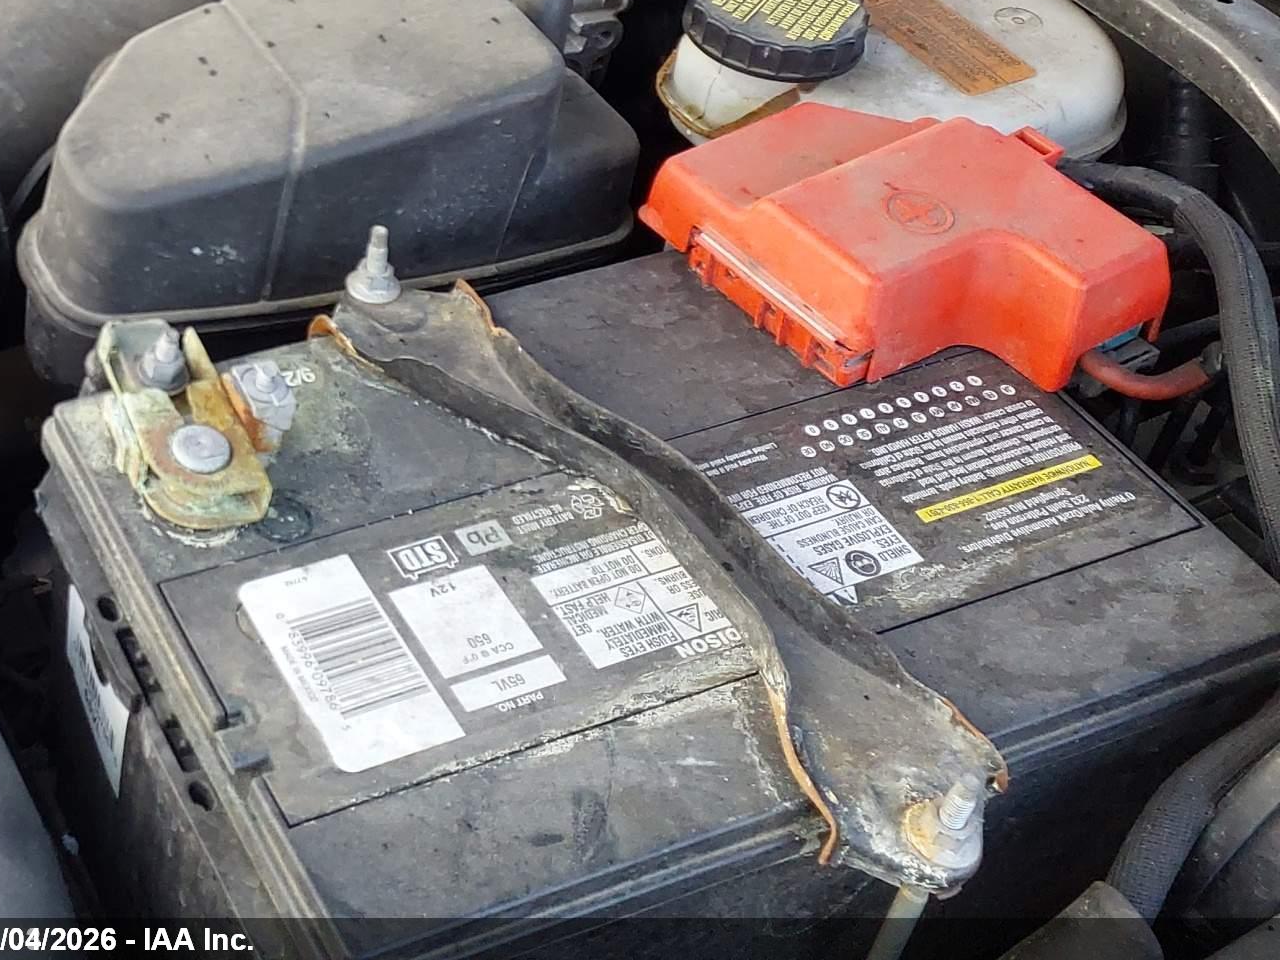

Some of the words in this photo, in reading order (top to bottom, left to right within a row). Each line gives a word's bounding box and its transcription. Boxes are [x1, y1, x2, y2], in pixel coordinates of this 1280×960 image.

[547, 503, 563, 513] BE
[783, 503, 799, 513] OF
[796, 496, 823, 508] REACH
[511, 507, 552, 524] RECYCLED
[791, 509, 812, 521] OUT
[808, 503, 832, 515] KEEP
[859, 507, 875, 516] OR
[538, 511, 573, 526] BATTERY
[765, 518, 784, 529] THE
[779, 514, 796, 524] OF
[831, 512, 862, 525] INJURY.
[862, 514, 883, 526] CAN
[516, 522, 540, 533] MUST
[837, 520, 866, 533] CAUSE
[464, 525, 502, 549] Pb
[795, 529, 840, 547] BLINDNESS
[841, 524, 892, 545] EXPLOSIVE
[872, 534, 901, 548] EYES.
[812, 540, 844, 555] GASES
[877, 545, 912, 561] SHIELD
[395, 540, 447, 570] STD
[619, 554, 636, 565] DO
[585, 564, 605, 575] TIP.
[602, 558, 622, 570] NOT
[626, 563, 642, 573] DO
[587, 574, 610, 585] OPEN
[609, 567, 629, 579] NOT
[428, 582, 456, 596] 12V
[549, 580, 587, 597] BATTERY.
[583, 592, 610, 606] HELP
[555, 601, 585, 615] FAST.
[562, 605, 608, 625] MEDICAL
[634, 612, 661, 625] WITH
[570, 623, 592, 635] GET
[596, 620, 635, 638] WATER.
[602, 622, 670, 649] IMMEDIATELY
[466, 633, 491, 647] 650
[644, 632, 678, 648] FLUSH
[491, 642, 513, 653] CCA
[619, 642, 646, 656] EYES
[491, 673, 525, 691] 65VL
[514, 691, 543, 705] PART
[495, 700, 515, 711] NO.
